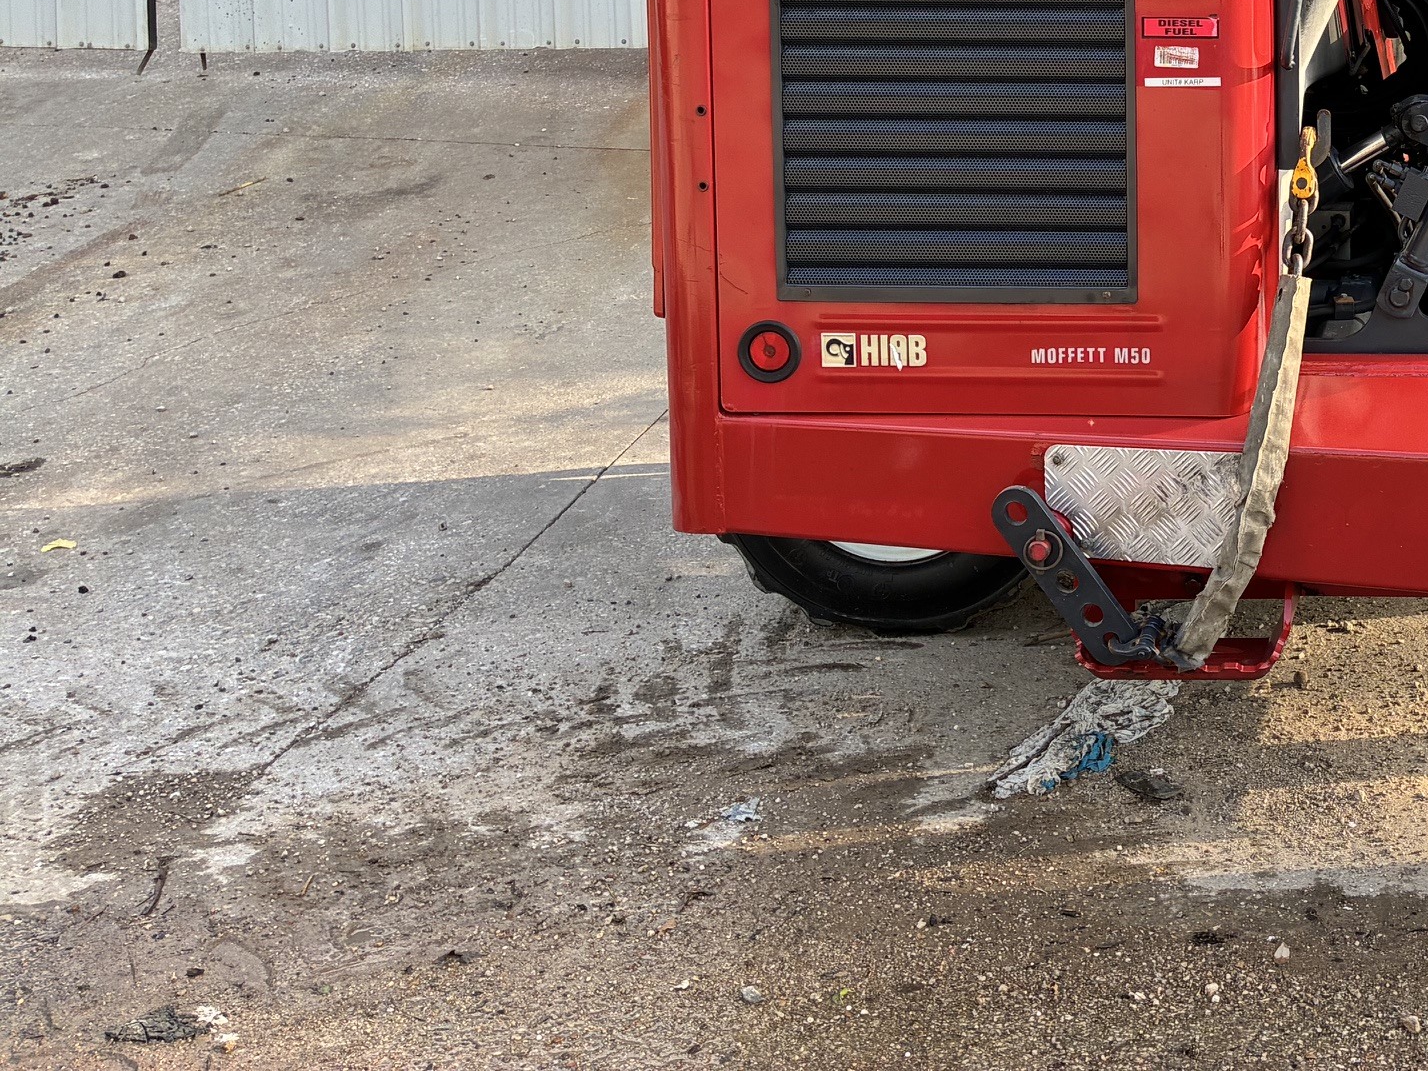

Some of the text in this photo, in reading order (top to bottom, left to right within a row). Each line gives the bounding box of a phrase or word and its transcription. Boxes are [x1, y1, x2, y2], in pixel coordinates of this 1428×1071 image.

[1158, 19, 1204, 28] DIESEL
[1164, 27, 1198, 36] FUEL
[860, 334, 928, 368] HIAB
[1030, 347, 1151, 365] MOFFETT M50
